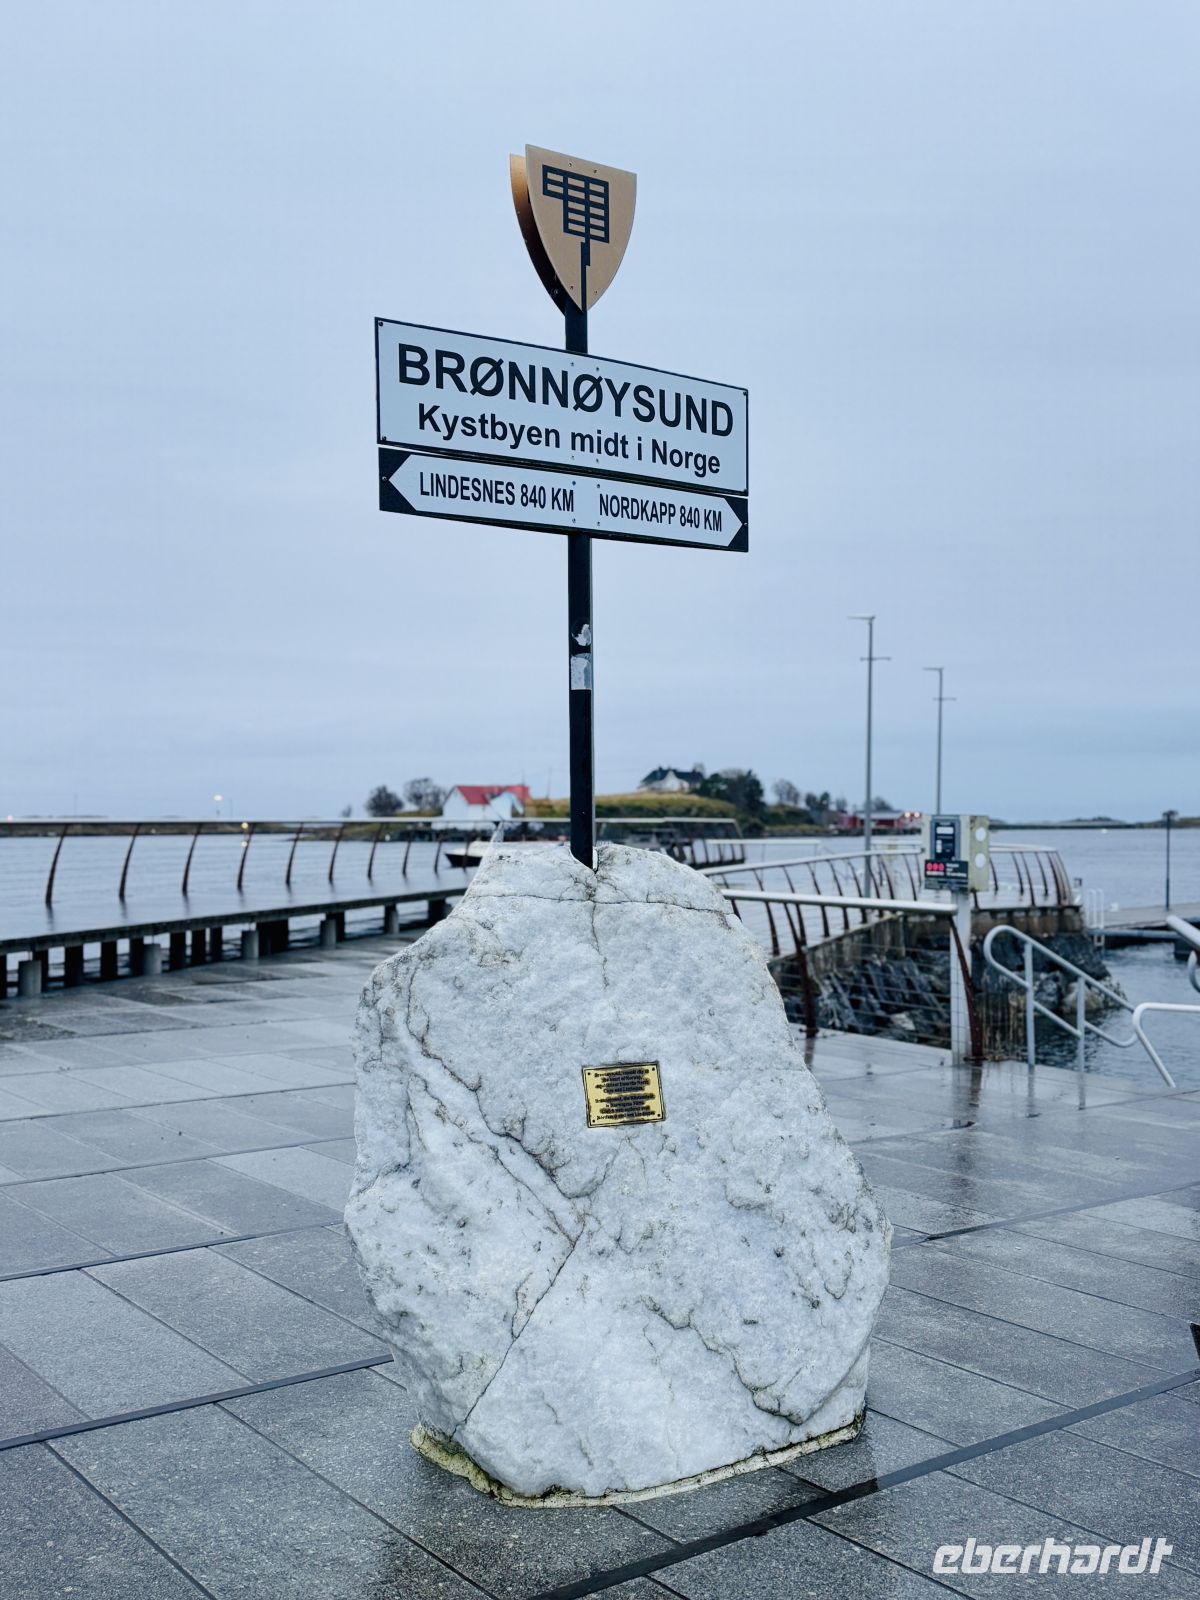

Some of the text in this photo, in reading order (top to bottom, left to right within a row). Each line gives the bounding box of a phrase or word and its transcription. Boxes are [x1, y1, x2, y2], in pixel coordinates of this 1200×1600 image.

[398, 342, 734, 437] BRØNNØYSUND
[418, 402, 721, 478] Kystbyen midt i Norge
[419, 471, 575, 513] LINDESNES 840 KM
[599, 493, 722, 533] NORDKAPP 840 KM
